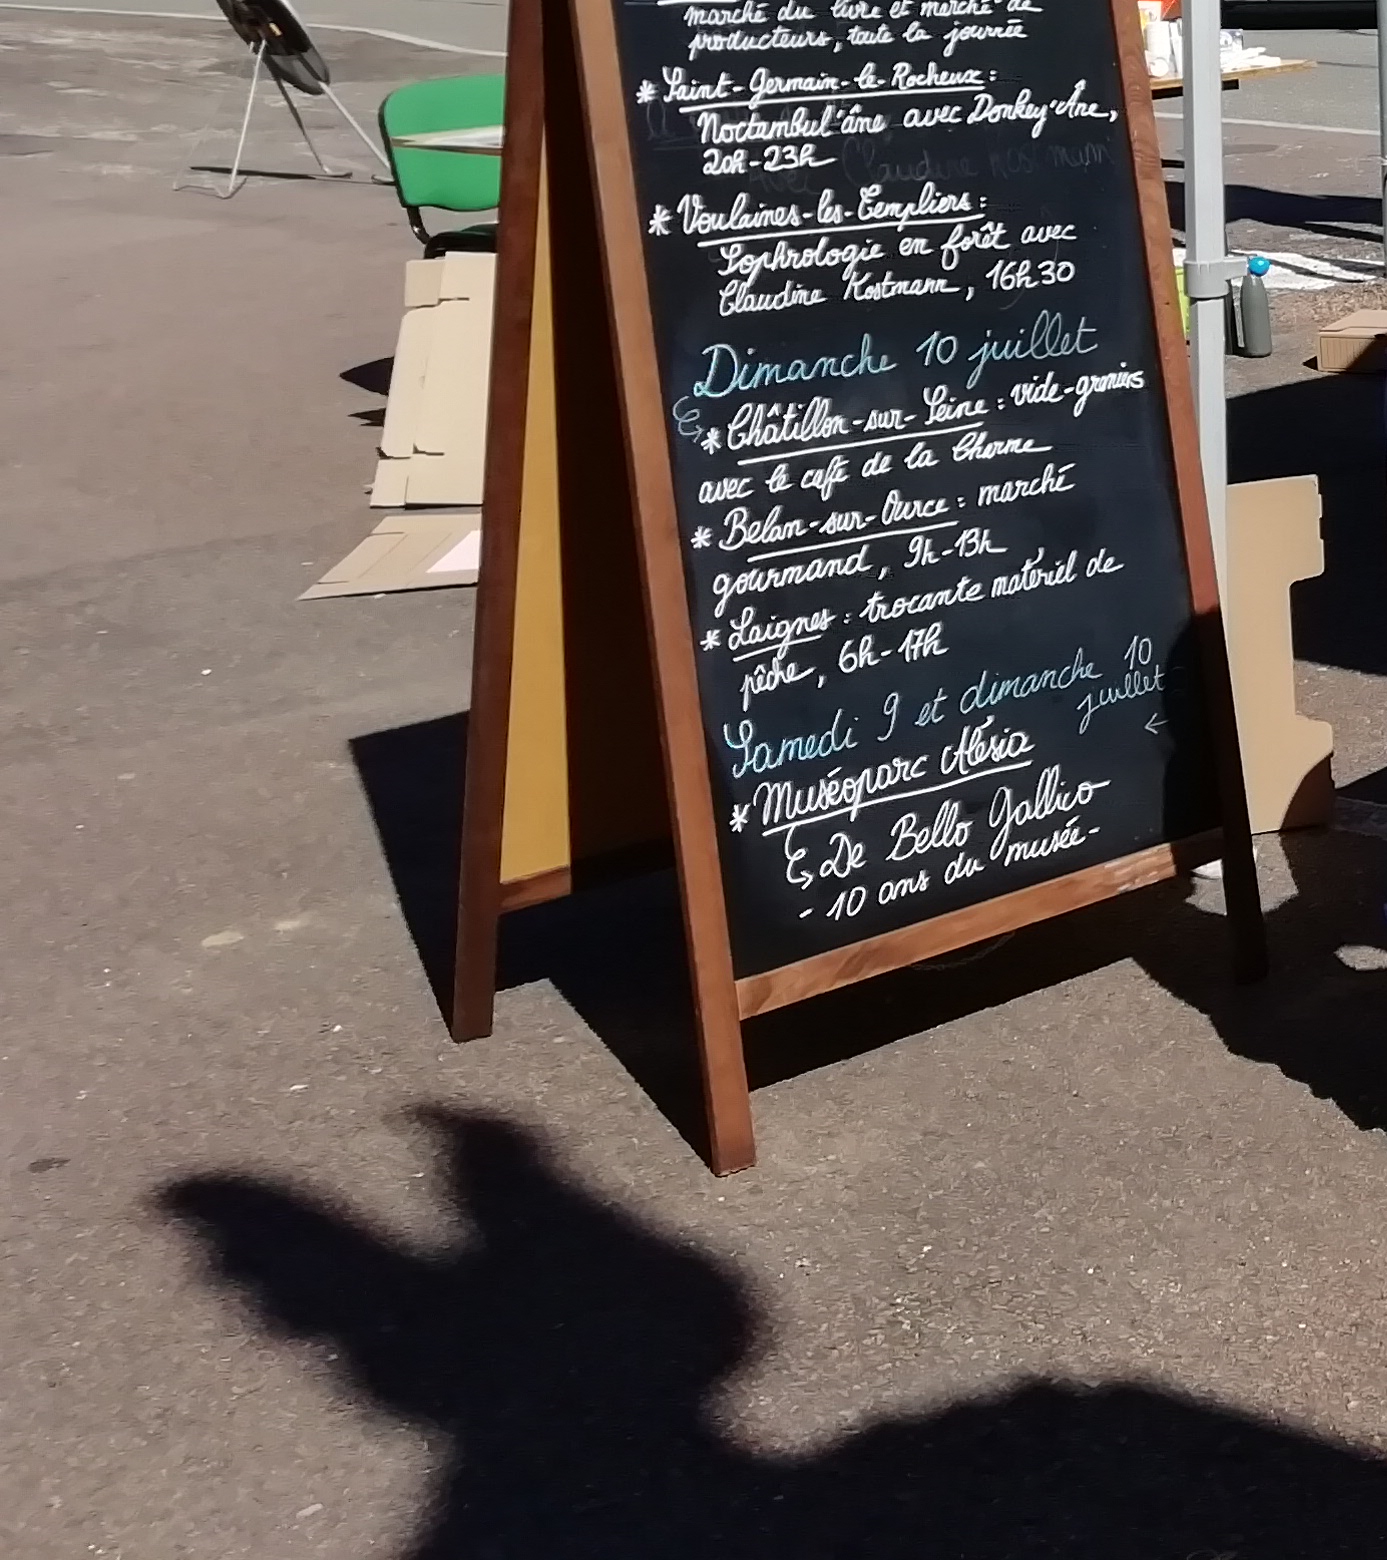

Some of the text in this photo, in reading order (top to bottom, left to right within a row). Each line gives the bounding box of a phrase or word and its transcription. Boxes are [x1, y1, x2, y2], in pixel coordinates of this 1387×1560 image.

[685, 1, 767, 25] marché
[777, 1, 815, 23] du
[901, 22, 936, 42] la
[944, 18, 1028, 56] journée
[904, 106, 962, 127] avec
[702, 145, 838, 175] 20h-23h
[717, 221, 1077, 275] Sophrologie en forêt avec
[718, 279, 828, 316] Claudine
[693, 310, 1099, 397] Dimanche 10 juillet
[726, 387, 991, 449] Châtillon-sur-Seine
[699, 475, 753, 504] avec
[765, 466, 794, 491] le
[800, 461, 849, 501] café
[862, 451, 893, 475] de
[904, 442, 939, 469] la
[719, 490, 951, 550] Belan-sur-Ource
[978, 464, 1076, 507] marché
[903, 528, 1008, 571] 9h-13h
[728, 611, 836, 652] Laignes
[860, 581, 985, 622] trocante
[991, 547, 1077, 599] matériel
[1085, 549, 1124, 577] de
[838, 623, 949, 674] 6h-17h
[723, 636, 1152, 778] Samedi 9 et dimanche 10
[1077, 670, 1166, 734] juillet
[754, 754, 927, 824] Muséoparc
[820, 764, 1110, 878] De Bello Gallico
[828, 885, 864, 921] 10
[878, 873, 928, 905] ans
[945, 851, 985, 884] du
